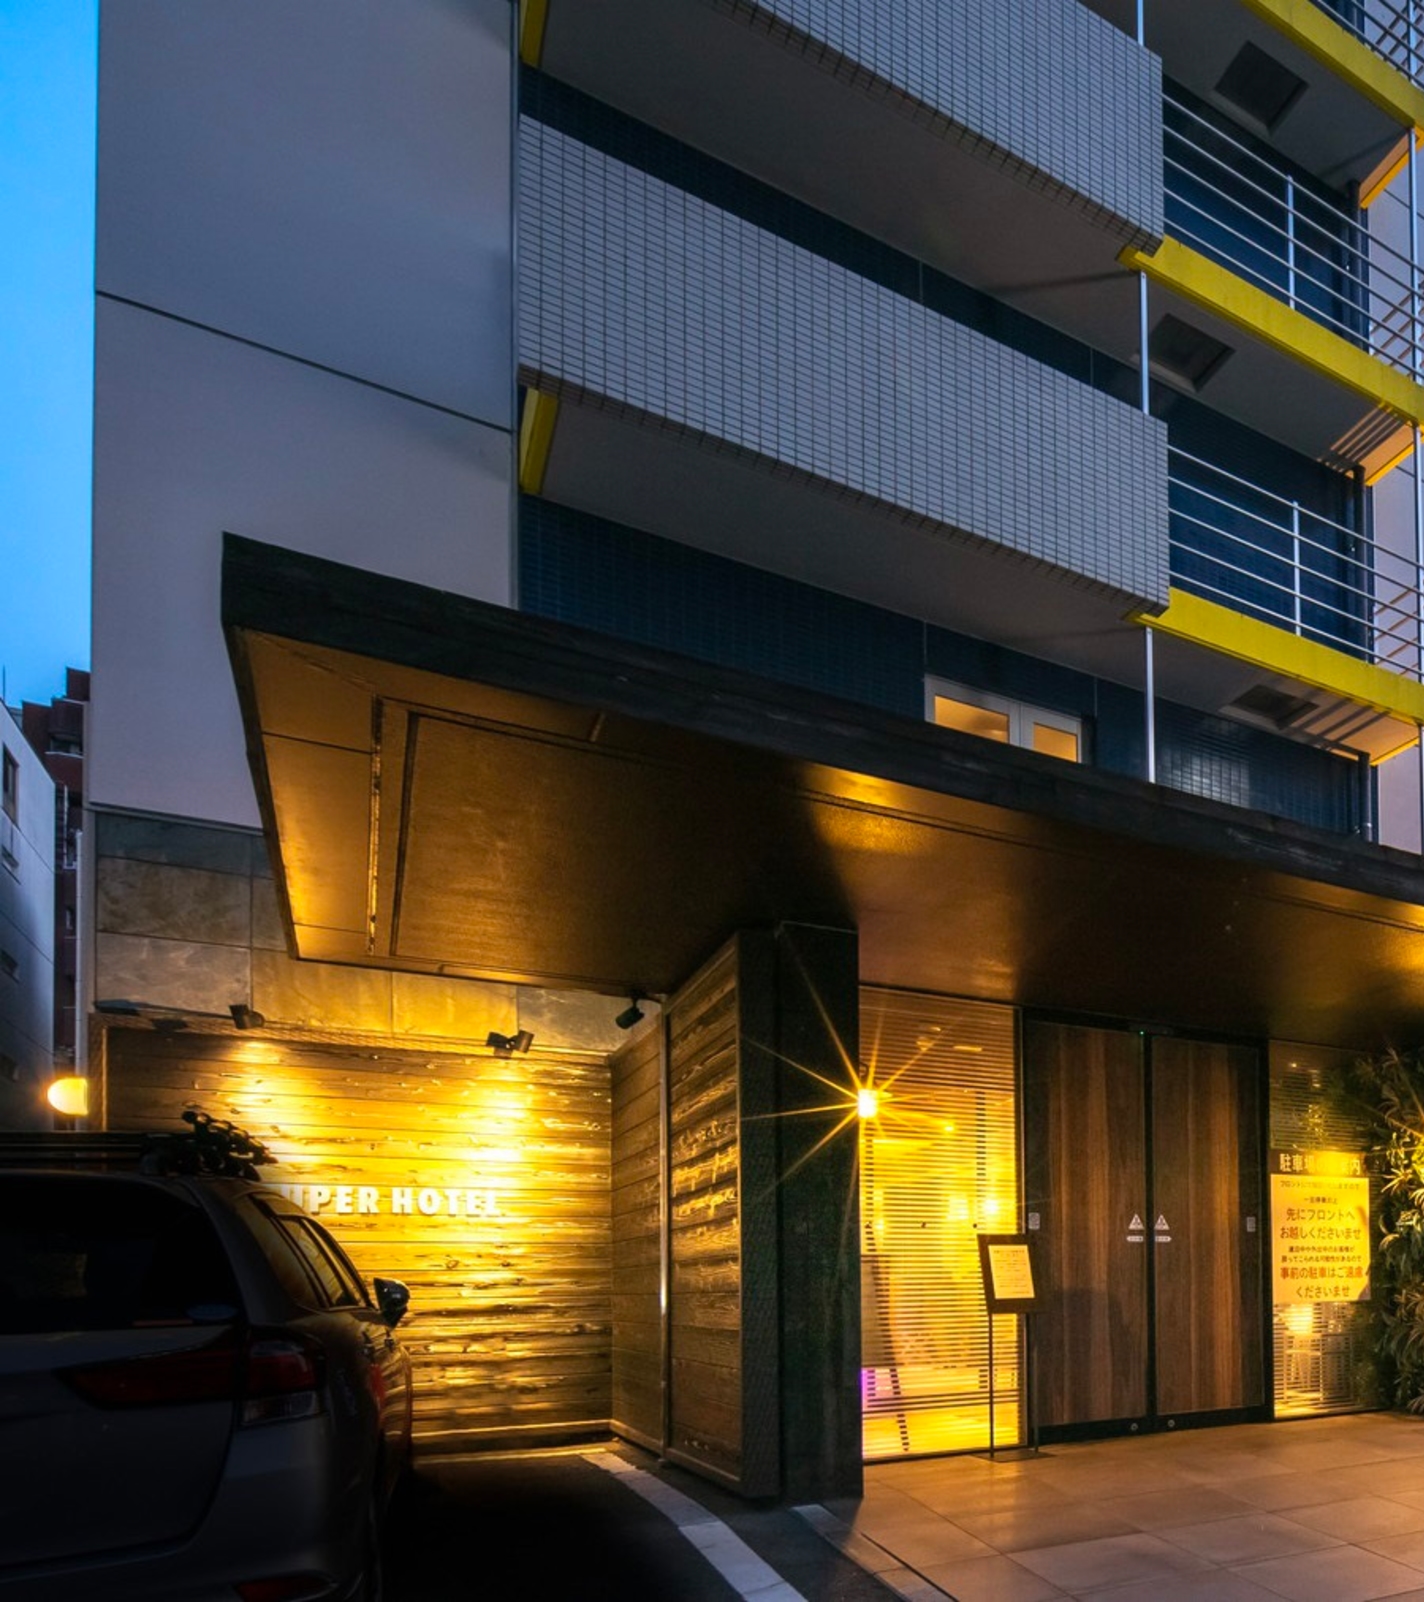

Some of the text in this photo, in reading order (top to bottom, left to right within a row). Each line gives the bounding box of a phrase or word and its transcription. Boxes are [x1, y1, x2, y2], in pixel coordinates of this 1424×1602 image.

[281, 1184, 501, 1216] UPER HOTEL
[1286, 1207, 1356, 1222] 先にフロントへ
[1280, 1226, 1362, 1241] お越しくださいませ
[1280, 1266, 1364, 1281] 事前の駐車はご遠慮
[1295, 1285, 1350, 1299] くださいませ
